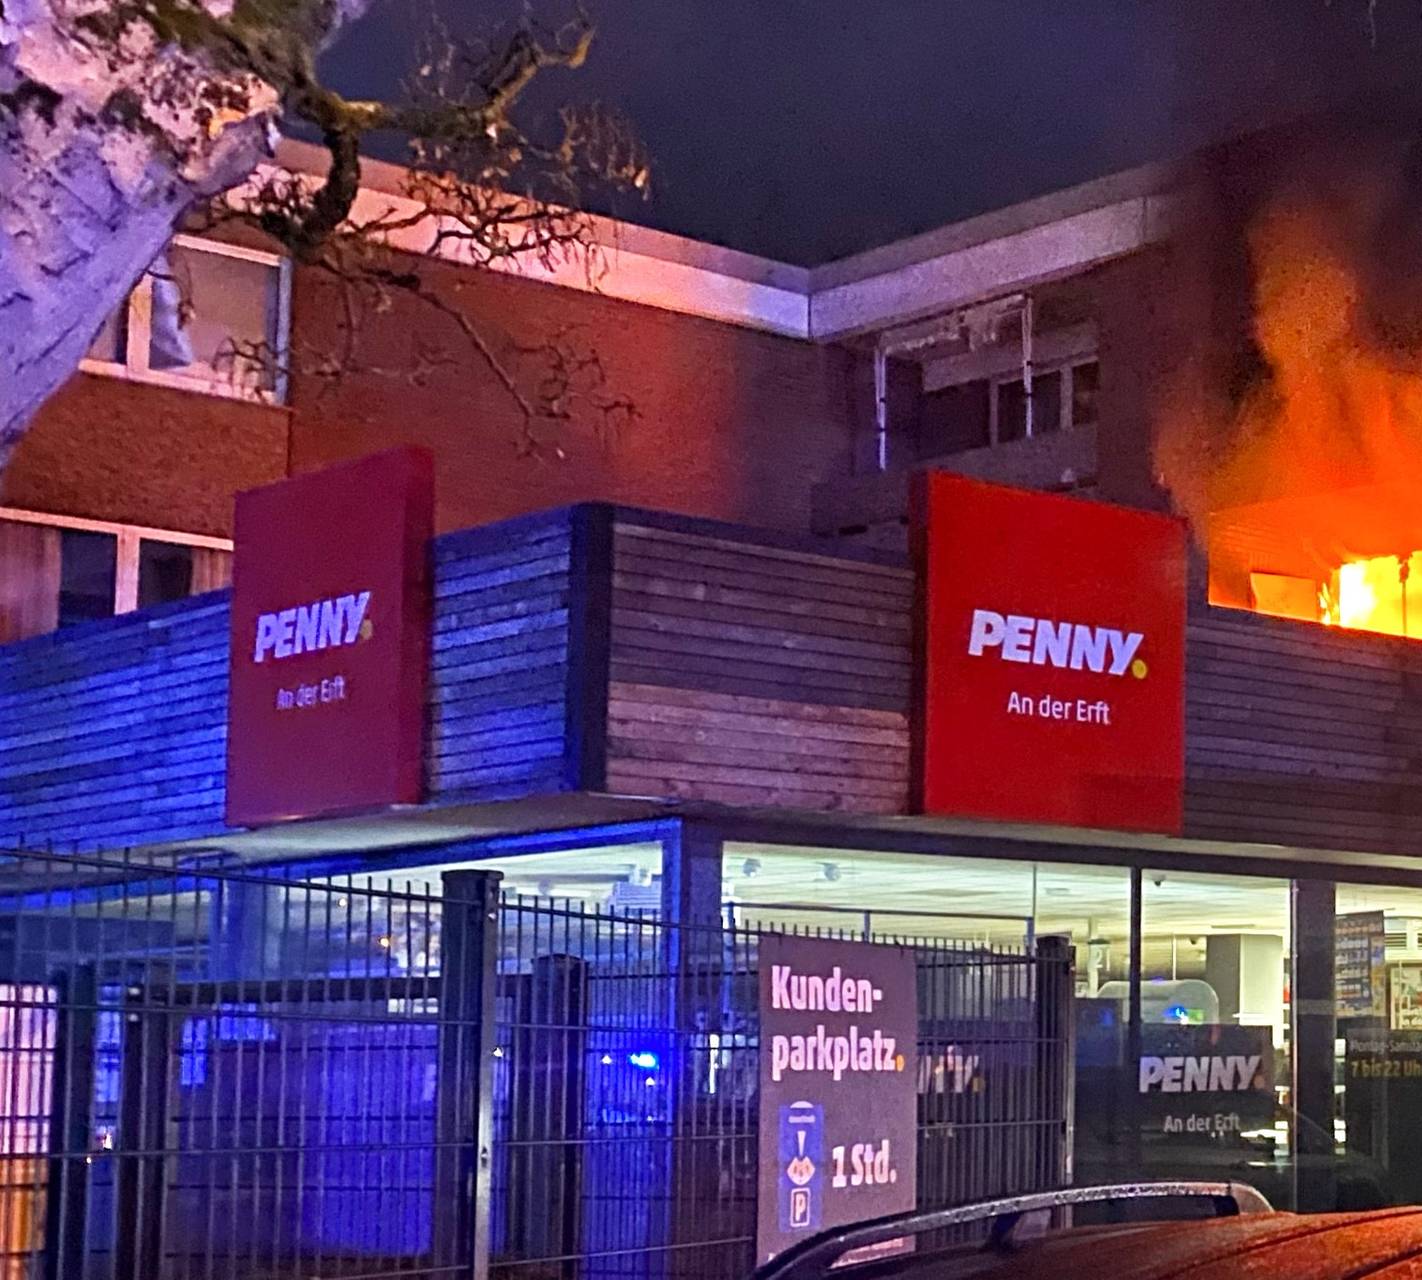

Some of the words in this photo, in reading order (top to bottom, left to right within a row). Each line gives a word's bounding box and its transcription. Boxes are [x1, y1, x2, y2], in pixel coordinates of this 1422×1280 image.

[1007, 691, 1034, 715] An
[1039, 695, 1072, 720] der
[1076, 700, 1111, 725] Erft
[772, 965, 883, 1013] Kunden-
[772, 1025, 905, 1081] parkplatz.
[1351, 1060, 1359, 1077] 7
[1361, 1057, 1381, 1077] bis
[1384, 1060, 1401, 1077] 22
[1163, 1115, 1183, 1133] An
[1186, 1113, 1211, 1132] der
[1214, 1113, 1241, 1131] Erft
[832, 1146, 847, 1188] 1
[851, 1139, 897, 1186] Std.
